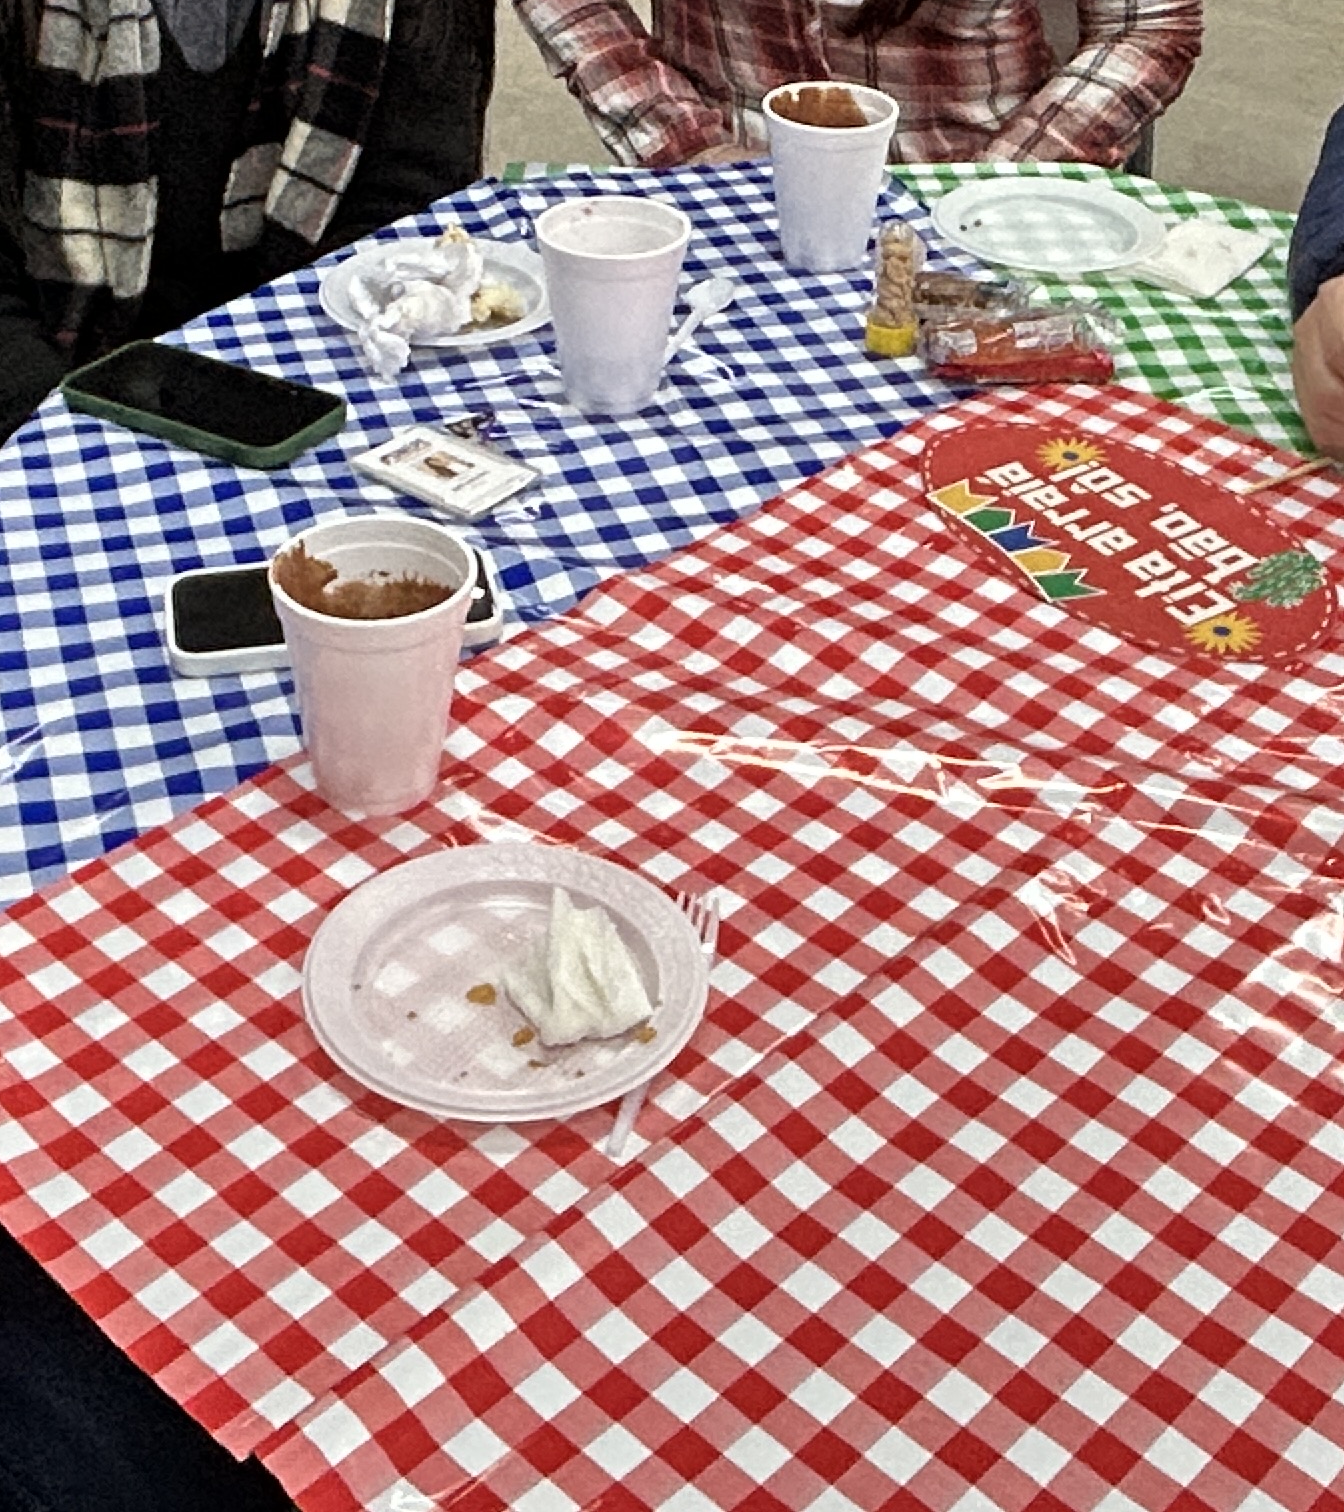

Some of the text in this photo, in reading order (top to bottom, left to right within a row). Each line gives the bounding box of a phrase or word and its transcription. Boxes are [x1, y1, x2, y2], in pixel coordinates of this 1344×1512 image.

[974, 461, 1237, 627] Eita arraiá
[1149, 503, 1259, 585] bão,
